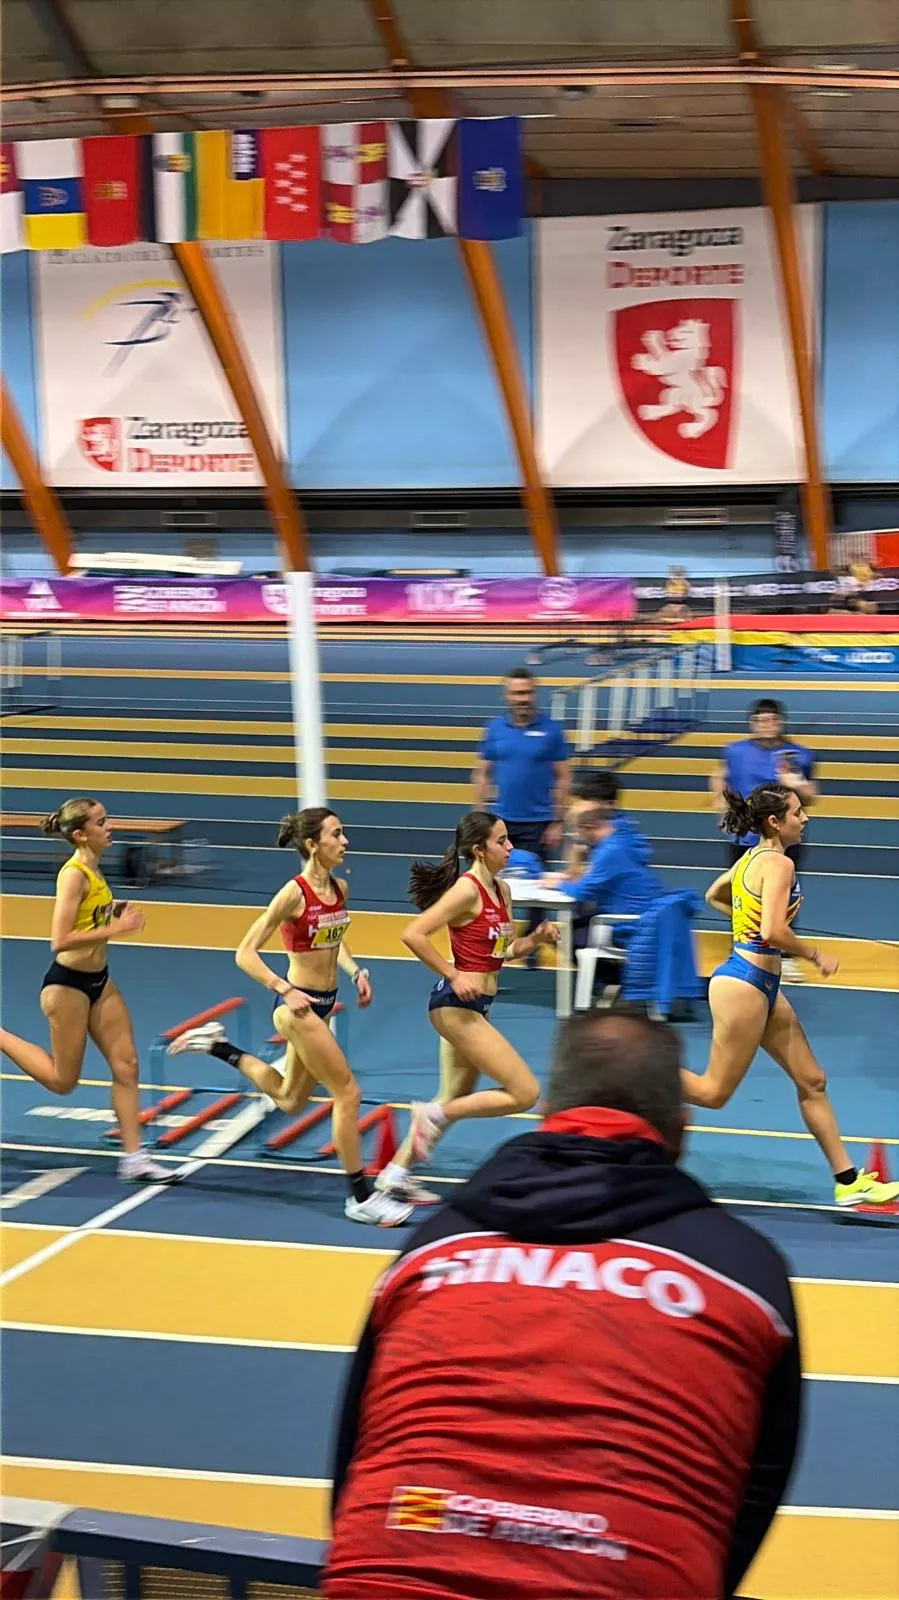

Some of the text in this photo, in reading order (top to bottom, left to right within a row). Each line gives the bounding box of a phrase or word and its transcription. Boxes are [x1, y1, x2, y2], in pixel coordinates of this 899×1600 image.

[606, 226, 743, 256] Zaragoza
[442, 1514, 490, 1537] DE
[446, 1495, 609, 1533] GOBIERNO
